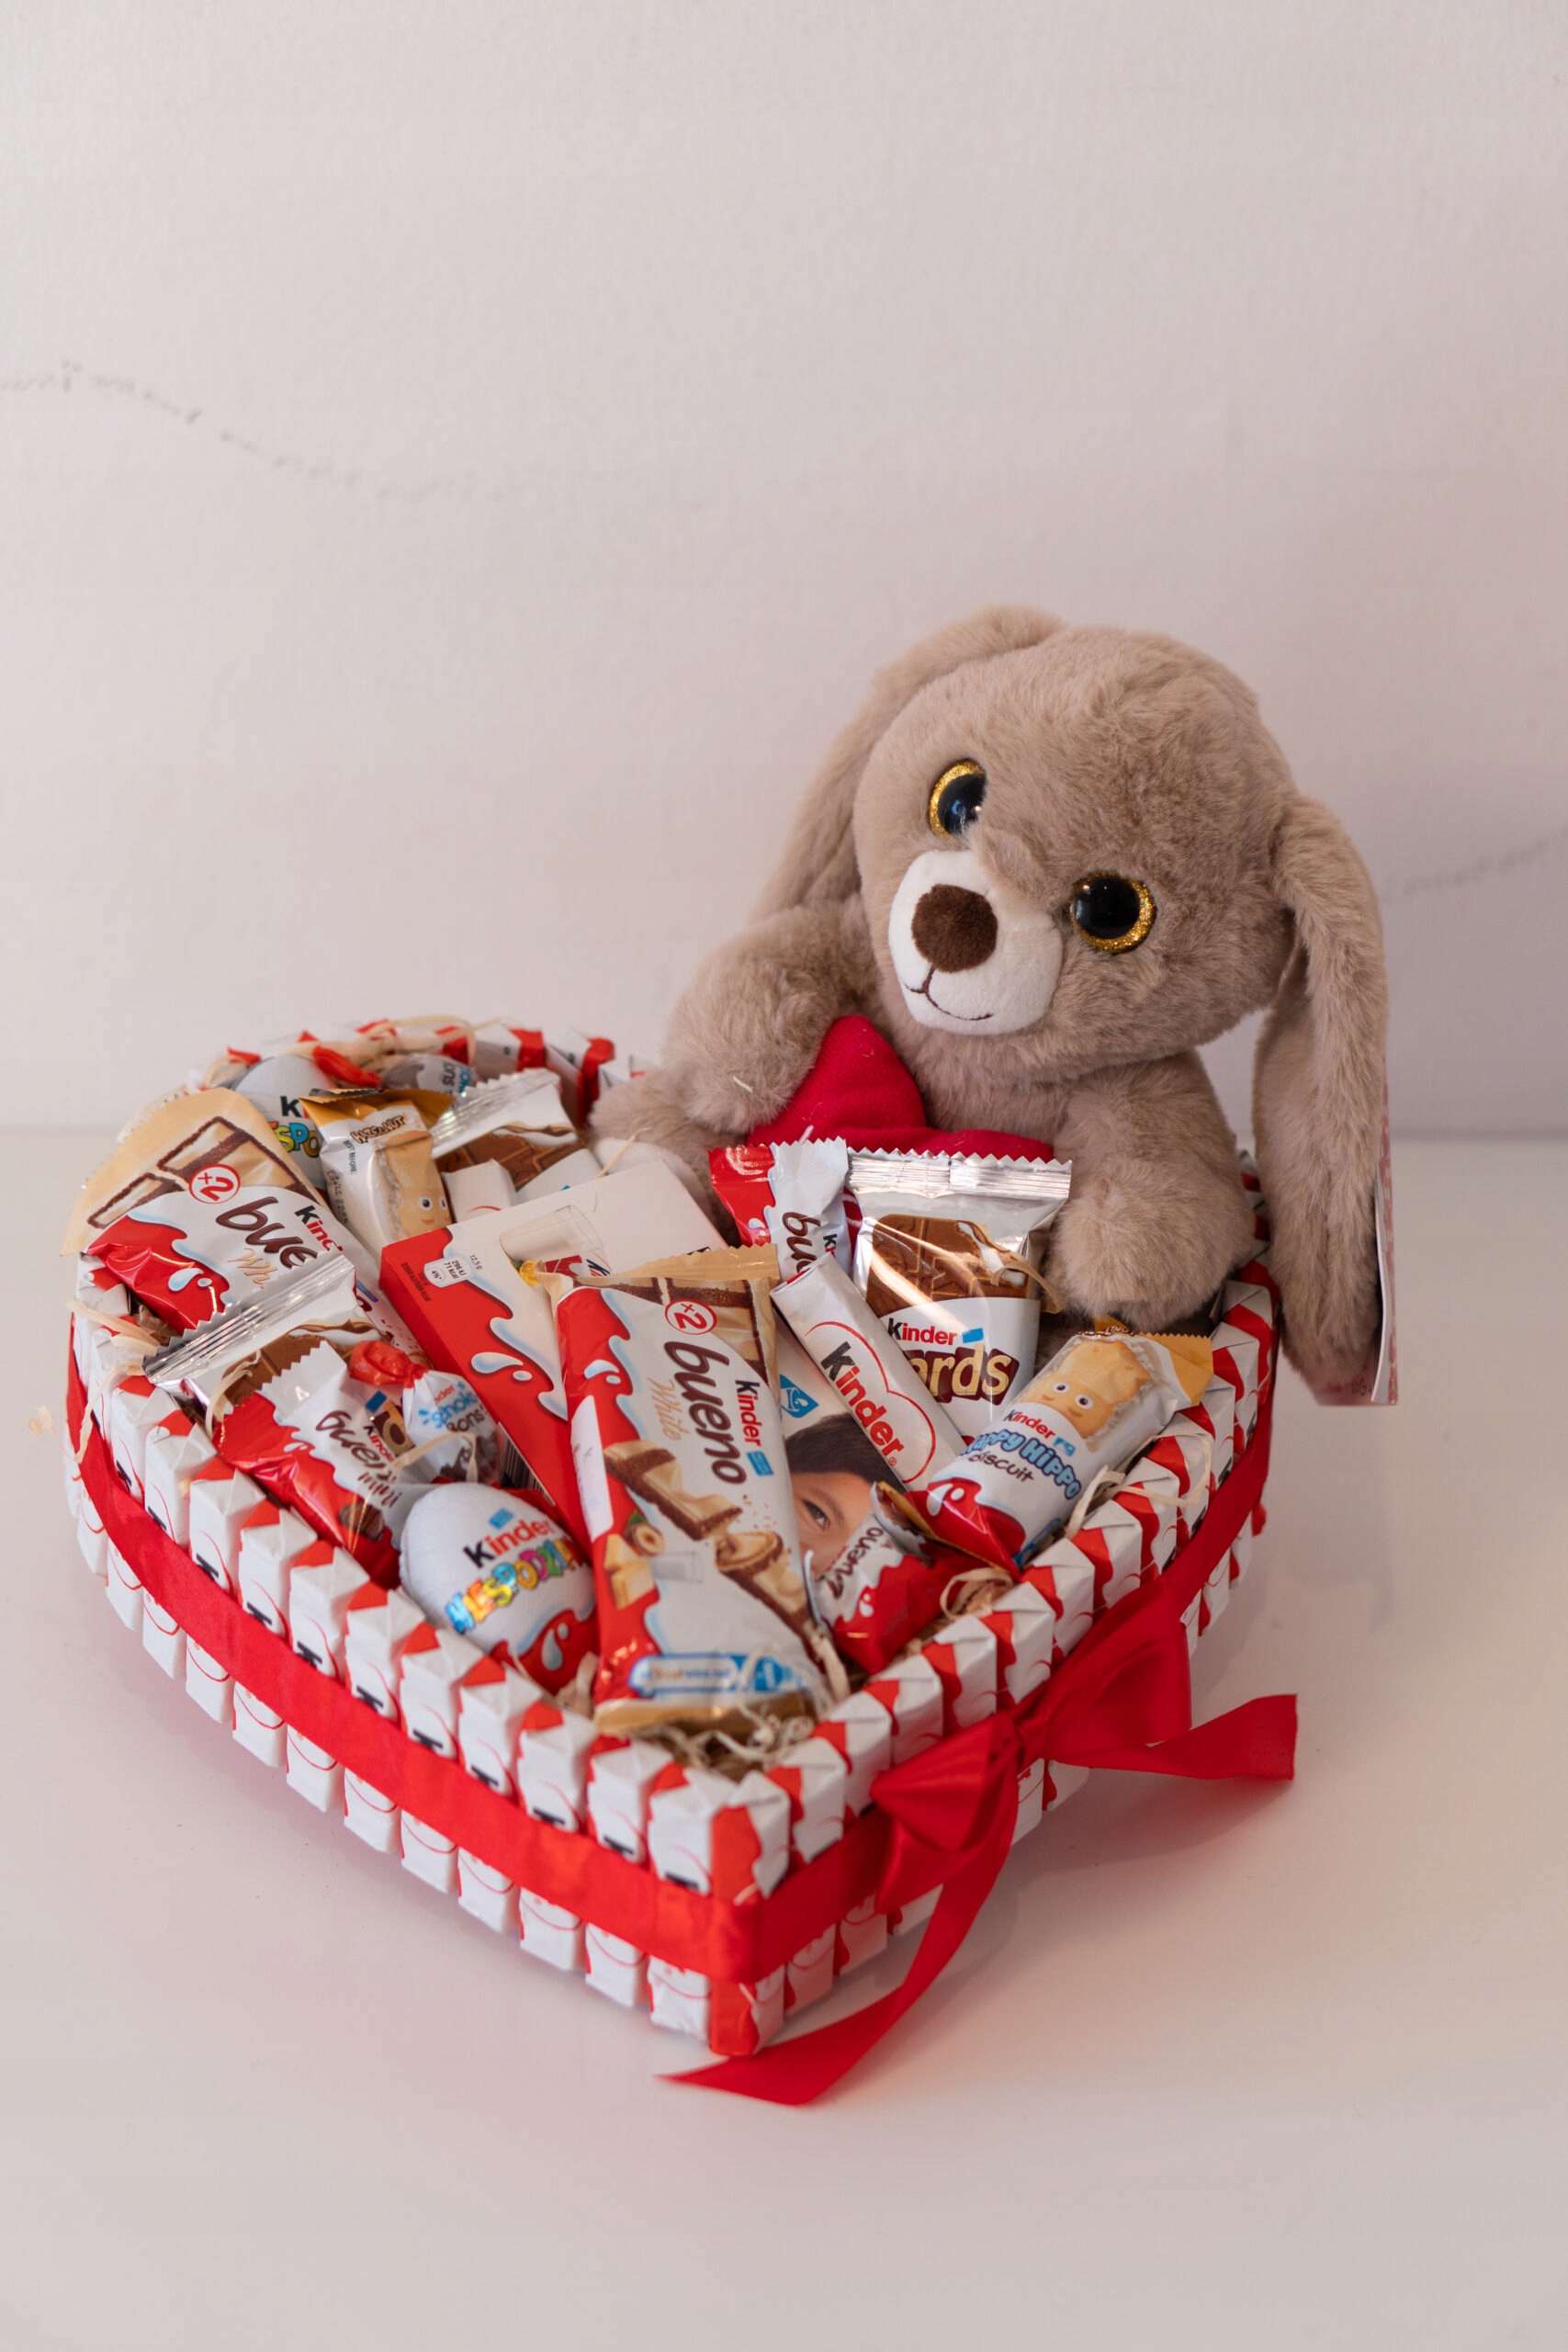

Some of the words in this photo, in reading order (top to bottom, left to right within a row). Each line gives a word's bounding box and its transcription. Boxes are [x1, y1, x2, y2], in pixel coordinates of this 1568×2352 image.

[887, 1317, 958, 1346] Kinder
[646, 1376, 690, 1441] White
[664, 1341, 747, 1485] bueno
[735, 1380, 762, 1447] Kinder
[820, 1340, 905, 1459] Kinder
[1003, 1409, 1055, 1440] Kinder
[463, 1519, 557, 1569] Kinder
